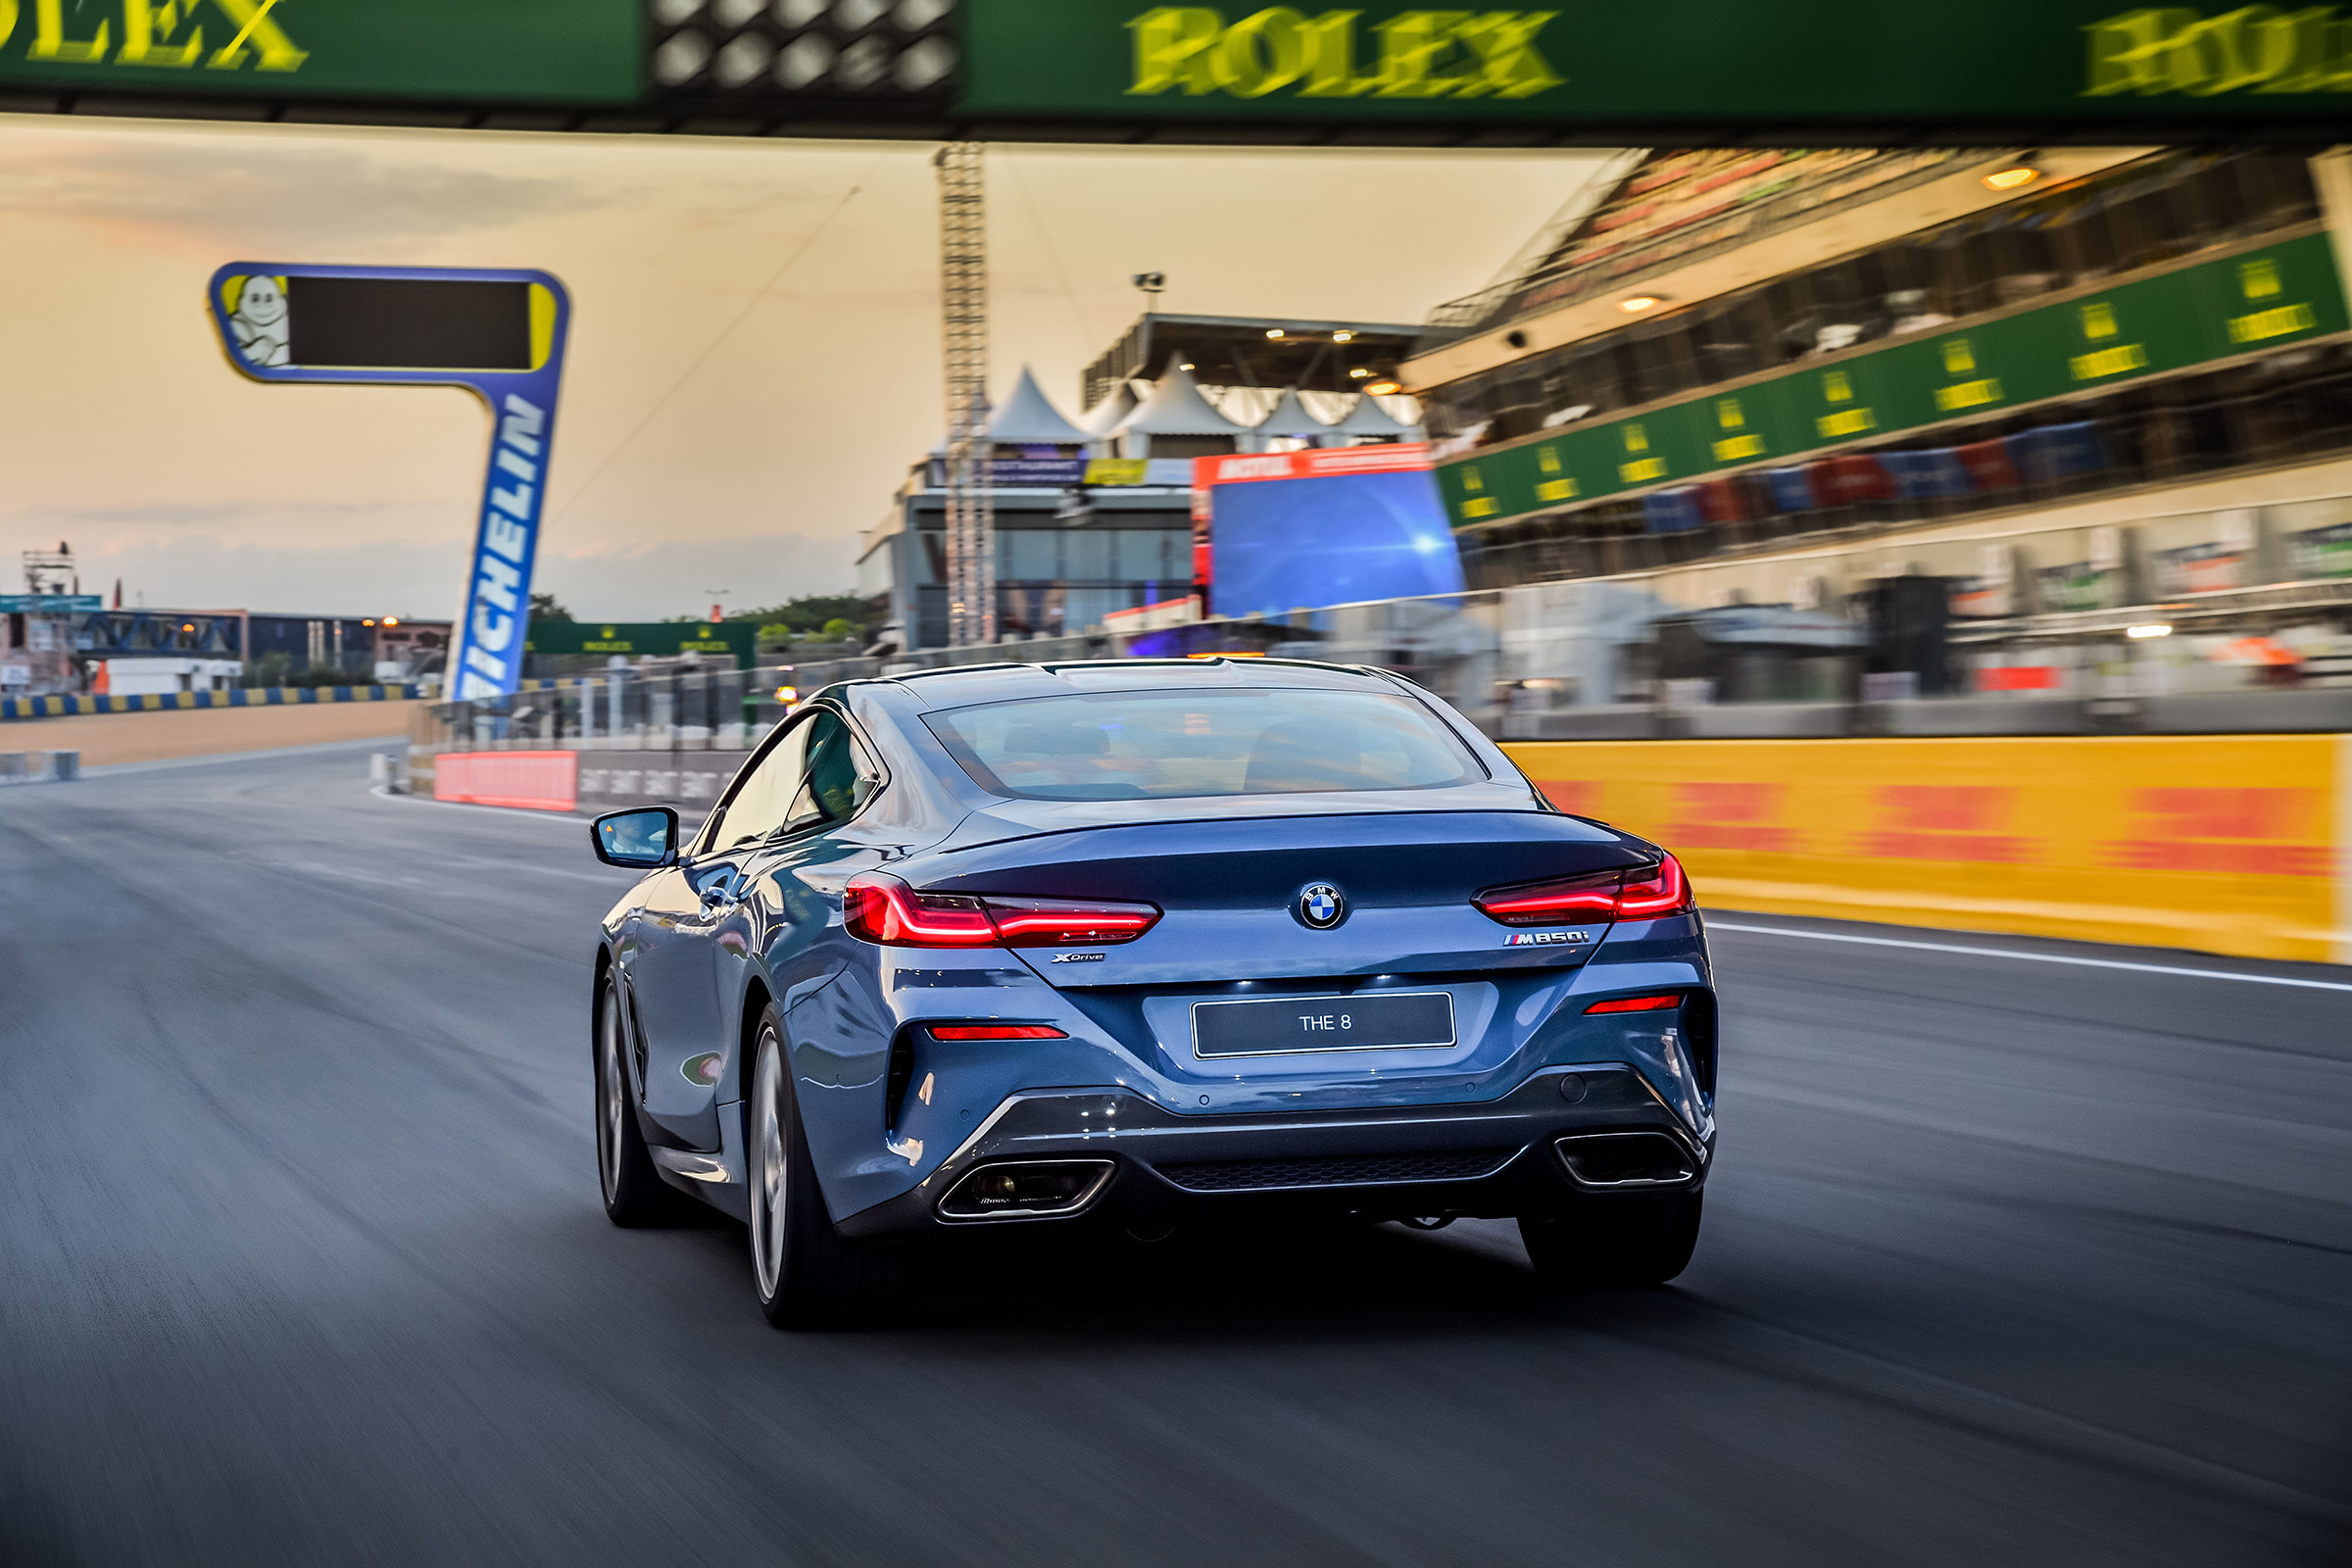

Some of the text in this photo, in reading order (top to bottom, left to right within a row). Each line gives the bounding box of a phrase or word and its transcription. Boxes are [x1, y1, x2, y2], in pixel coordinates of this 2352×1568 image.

[0, 0, 310, 73] LEX
[1124, 7, 1566, 97] ROLEX
[1304, 887, 1340, 901] BMW
[1514, 930, 1590, 945] M850i
[1298, 1014, 1351, 1031] THE 8
